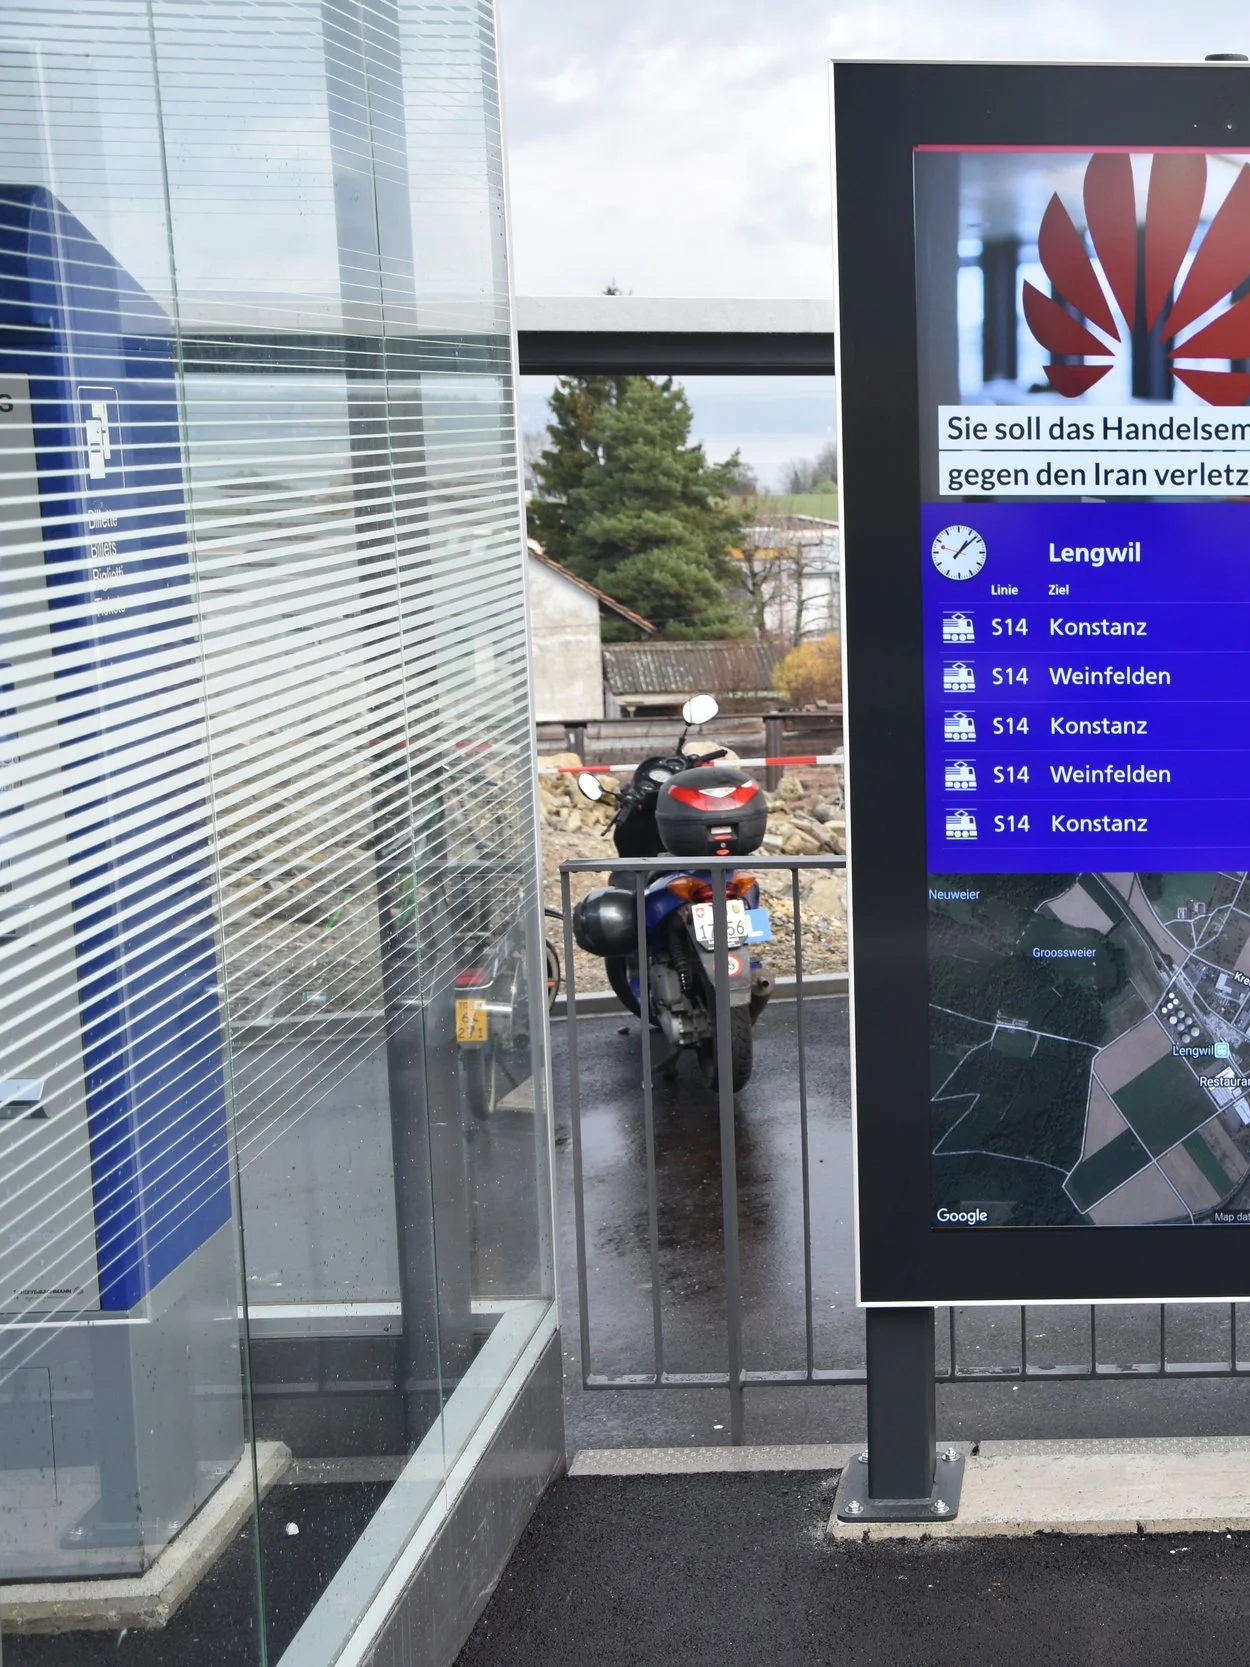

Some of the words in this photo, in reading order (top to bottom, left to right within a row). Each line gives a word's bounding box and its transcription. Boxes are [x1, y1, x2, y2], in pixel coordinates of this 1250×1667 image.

[947, 416, 988, 440] Sie
[995, 415, 1041, 441] soll
[1048, 416, 1095, 441] das
[947, 466, 1029, 491] gegen
[1036, 461, 1086, 486] den
[1094, 462, 1147, 486] Iran
[1049, 541, 1141, 567] Lengwil
[991, 584, 1019, 596] Linie
[1048, 584, 1070, 596] Ziel
[991, 617, 1029, 636] S14
[1050, 617, 1147, 636] Konstanz
[992, 666, 1030, 685] S14
[1048, 666, 1171, 685] Weinfelden
[992, 716, 1030, 735] S14
[1051, 716, 1148, 735] Konstanz
[993, 764, 1031, 784] S14
[1049, 764, 1171, 784] Weinfelden
[994, 814, 1032, 833] S14
[1051, 814, 1148, 833] Konstanz
[928, 889, 980, 901] Neuweier
[1032, 947, 1097, 959] Groossweier
[1172, 1046, 1214, 1059] Lengwil
[936, 1207, 988, 1225] Google
[1214, 1212, 1234, 1222] Map
